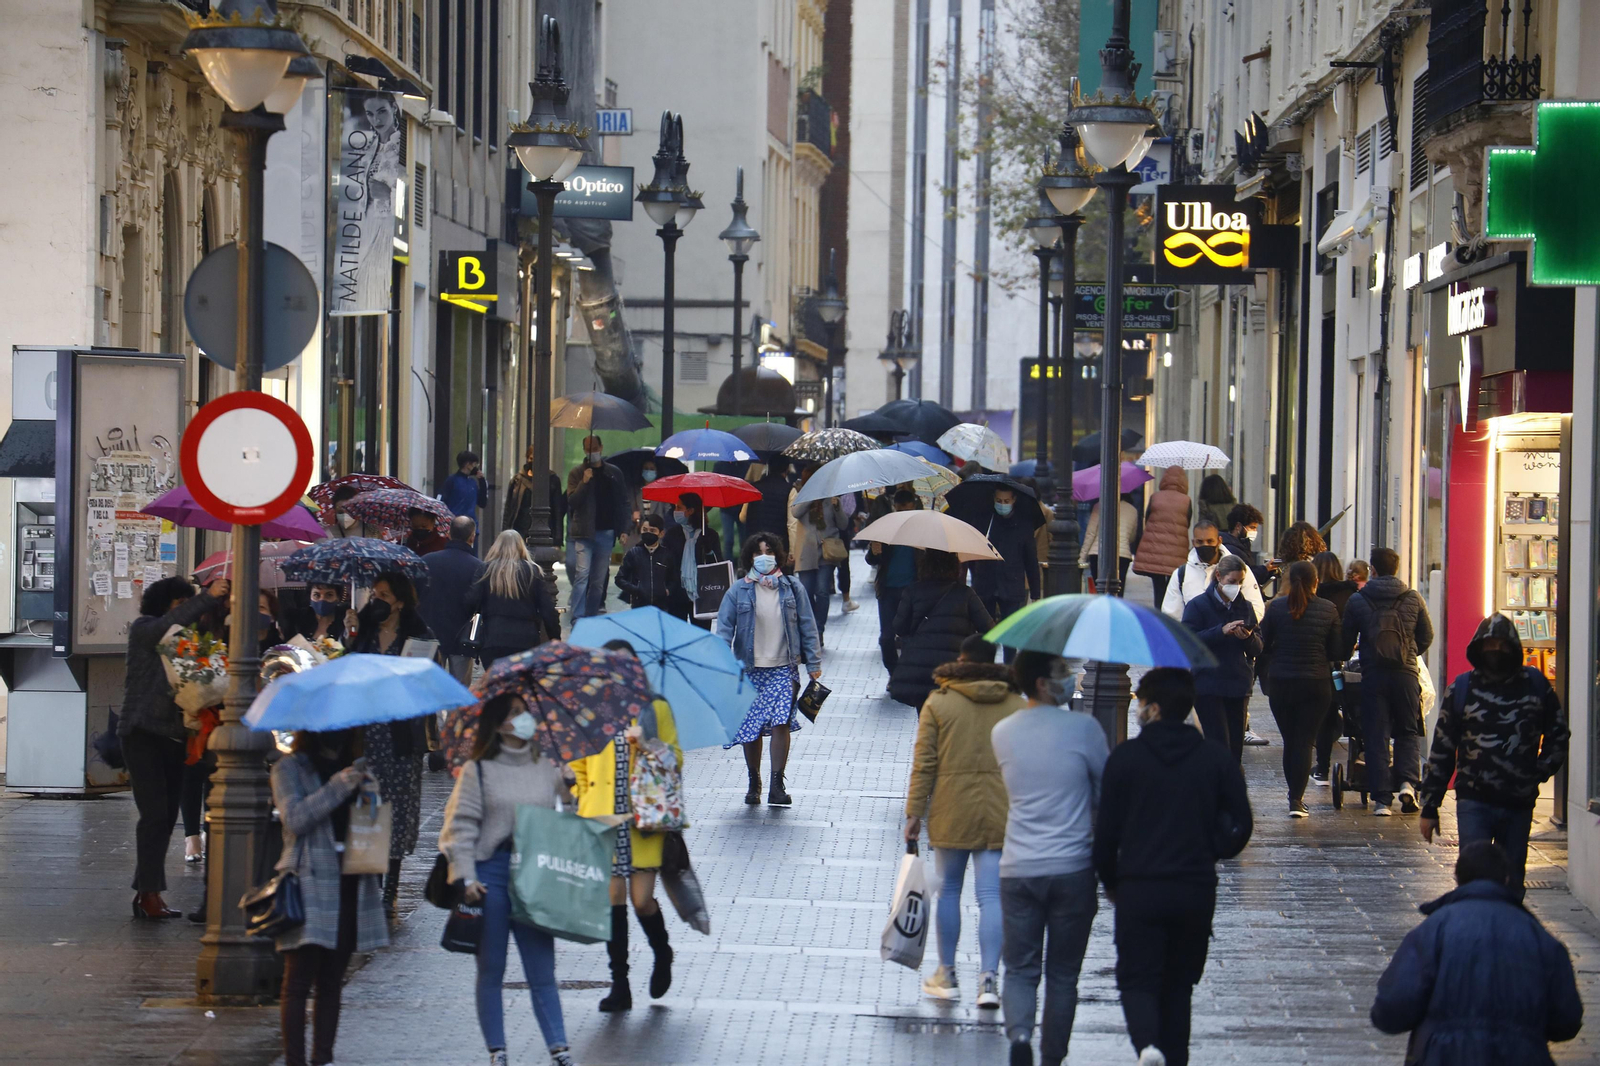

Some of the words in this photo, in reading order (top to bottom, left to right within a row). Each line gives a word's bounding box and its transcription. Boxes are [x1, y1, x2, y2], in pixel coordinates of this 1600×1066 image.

[345, 130, 368, 202] CANO
[572, 176, 624, 196] Optico
[1164, 202, 1250, 231] Ulloa
[339, 210, 362, 302] MATILDE
[458, 256, 486, 290] B
[1123, 286, 1173, 296] NMOBILIARIA
[847, 481, 868, 489] cajasur
